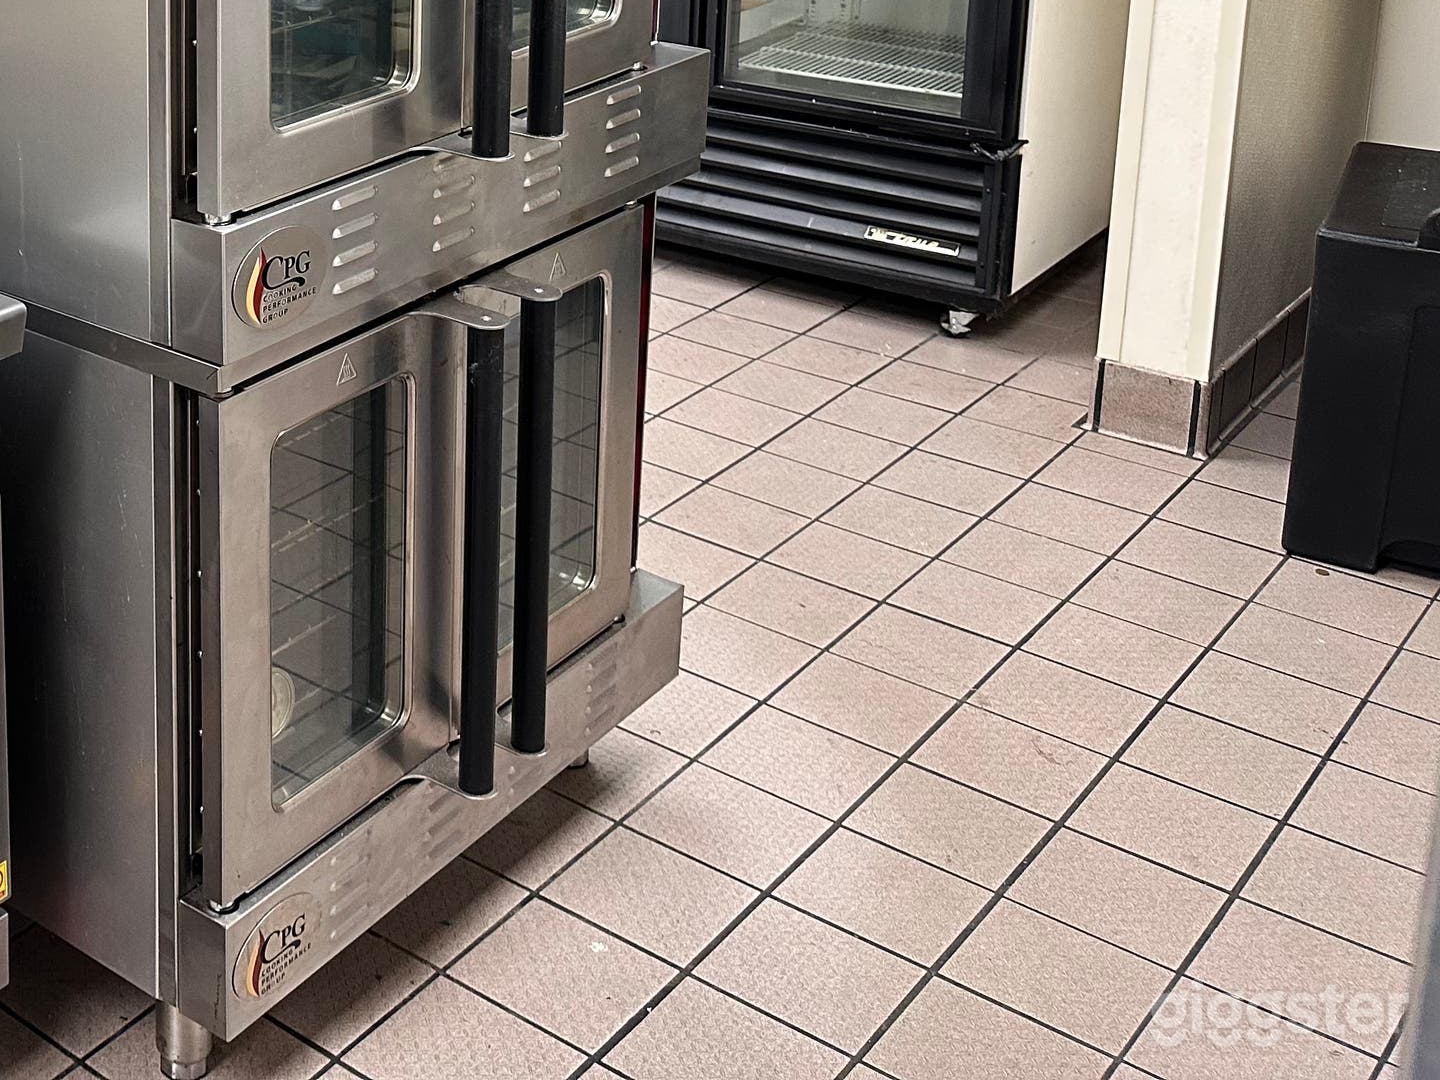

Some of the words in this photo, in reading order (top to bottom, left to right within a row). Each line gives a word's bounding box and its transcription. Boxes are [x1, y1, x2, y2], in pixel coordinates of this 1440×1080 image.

[261, 250, 311, 290] CPG
[262, 284, 297, 303] COOKING
[262, 287, 317, 313] PERFORMANCE
[262, 308, 289, 324] GROUP
[261, 912, 306, 964] CPG
